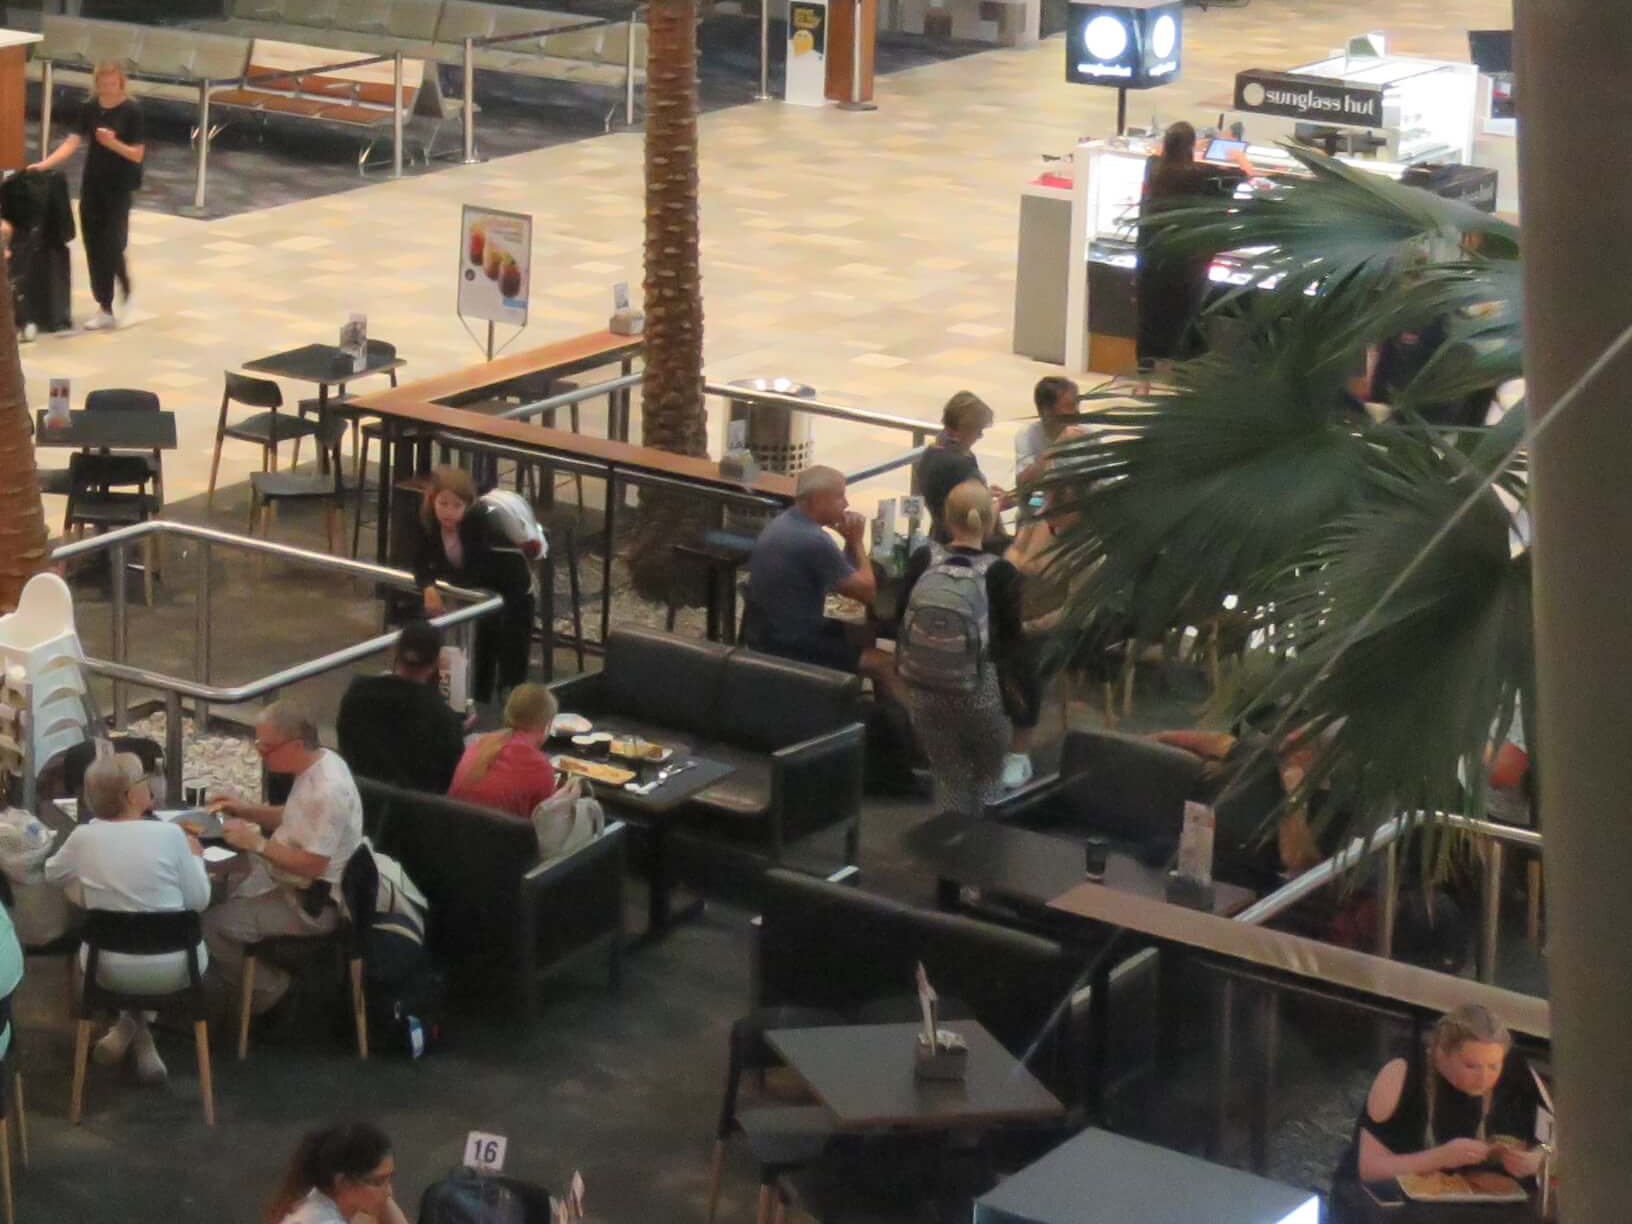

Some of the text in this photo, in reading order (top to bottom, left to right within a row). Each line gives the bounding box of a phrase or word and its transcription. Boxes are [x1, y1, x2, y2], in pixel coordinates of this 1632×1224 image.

[1266, 89, 1375, 116] sunglass hut
[474, 1139, 498, 1164] 16
